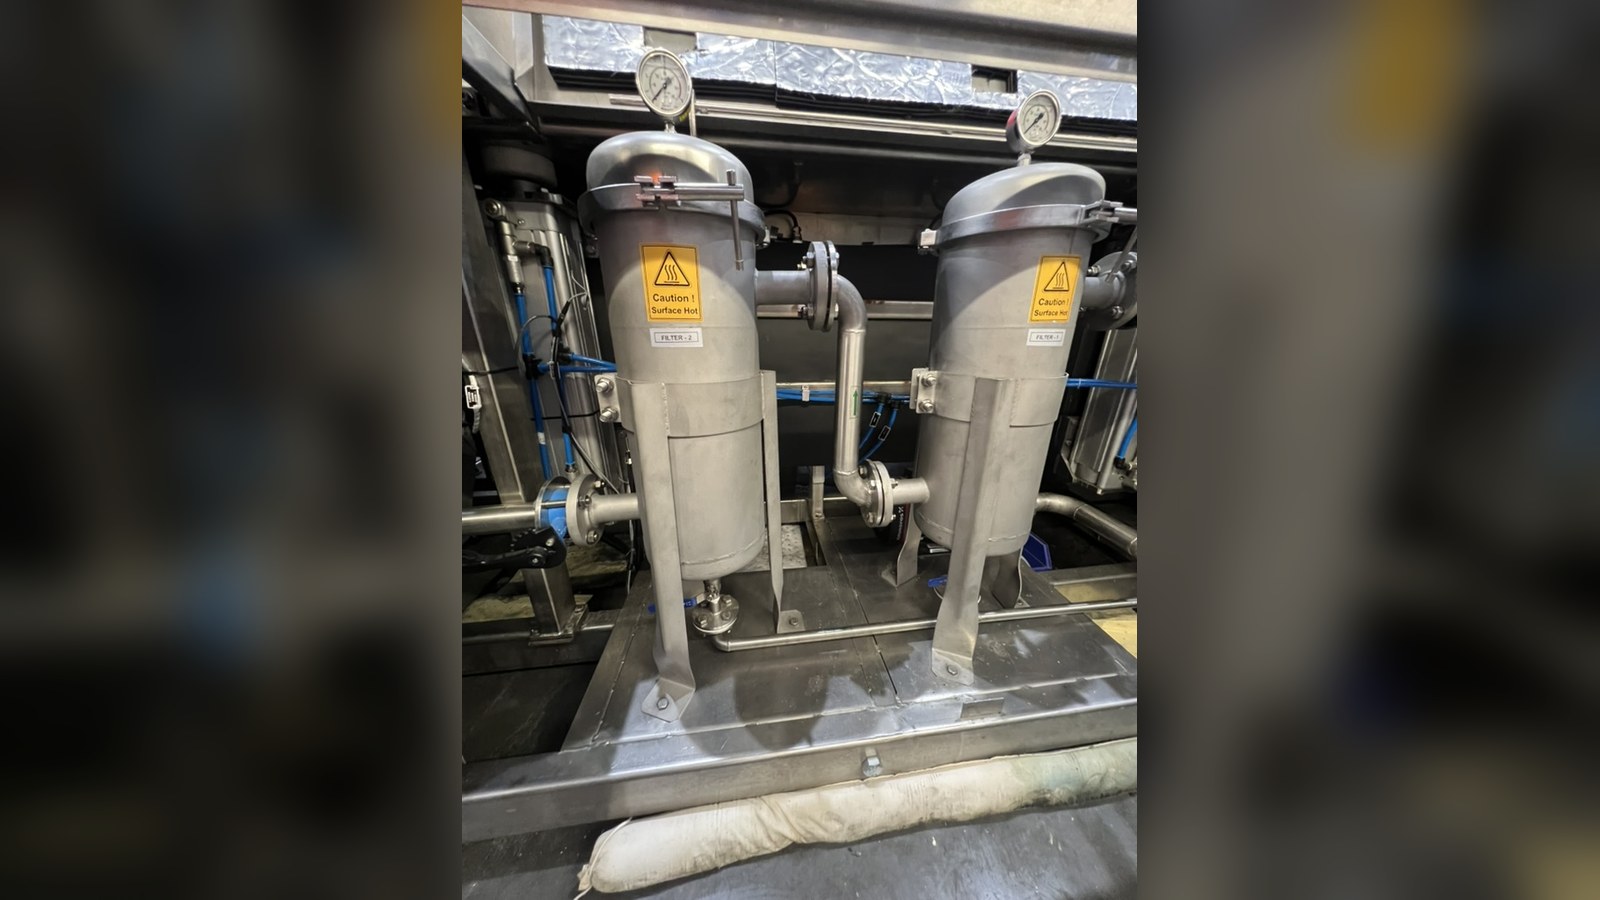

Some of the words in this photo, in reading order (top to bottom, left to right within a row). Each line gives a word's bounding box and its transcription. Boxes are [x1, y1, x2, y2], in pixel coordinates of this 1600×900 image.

[652, 293, 689, 302] Caution
[1038, 298, 1065, 306] Caution
[651, 306, 682, 314] Surface
